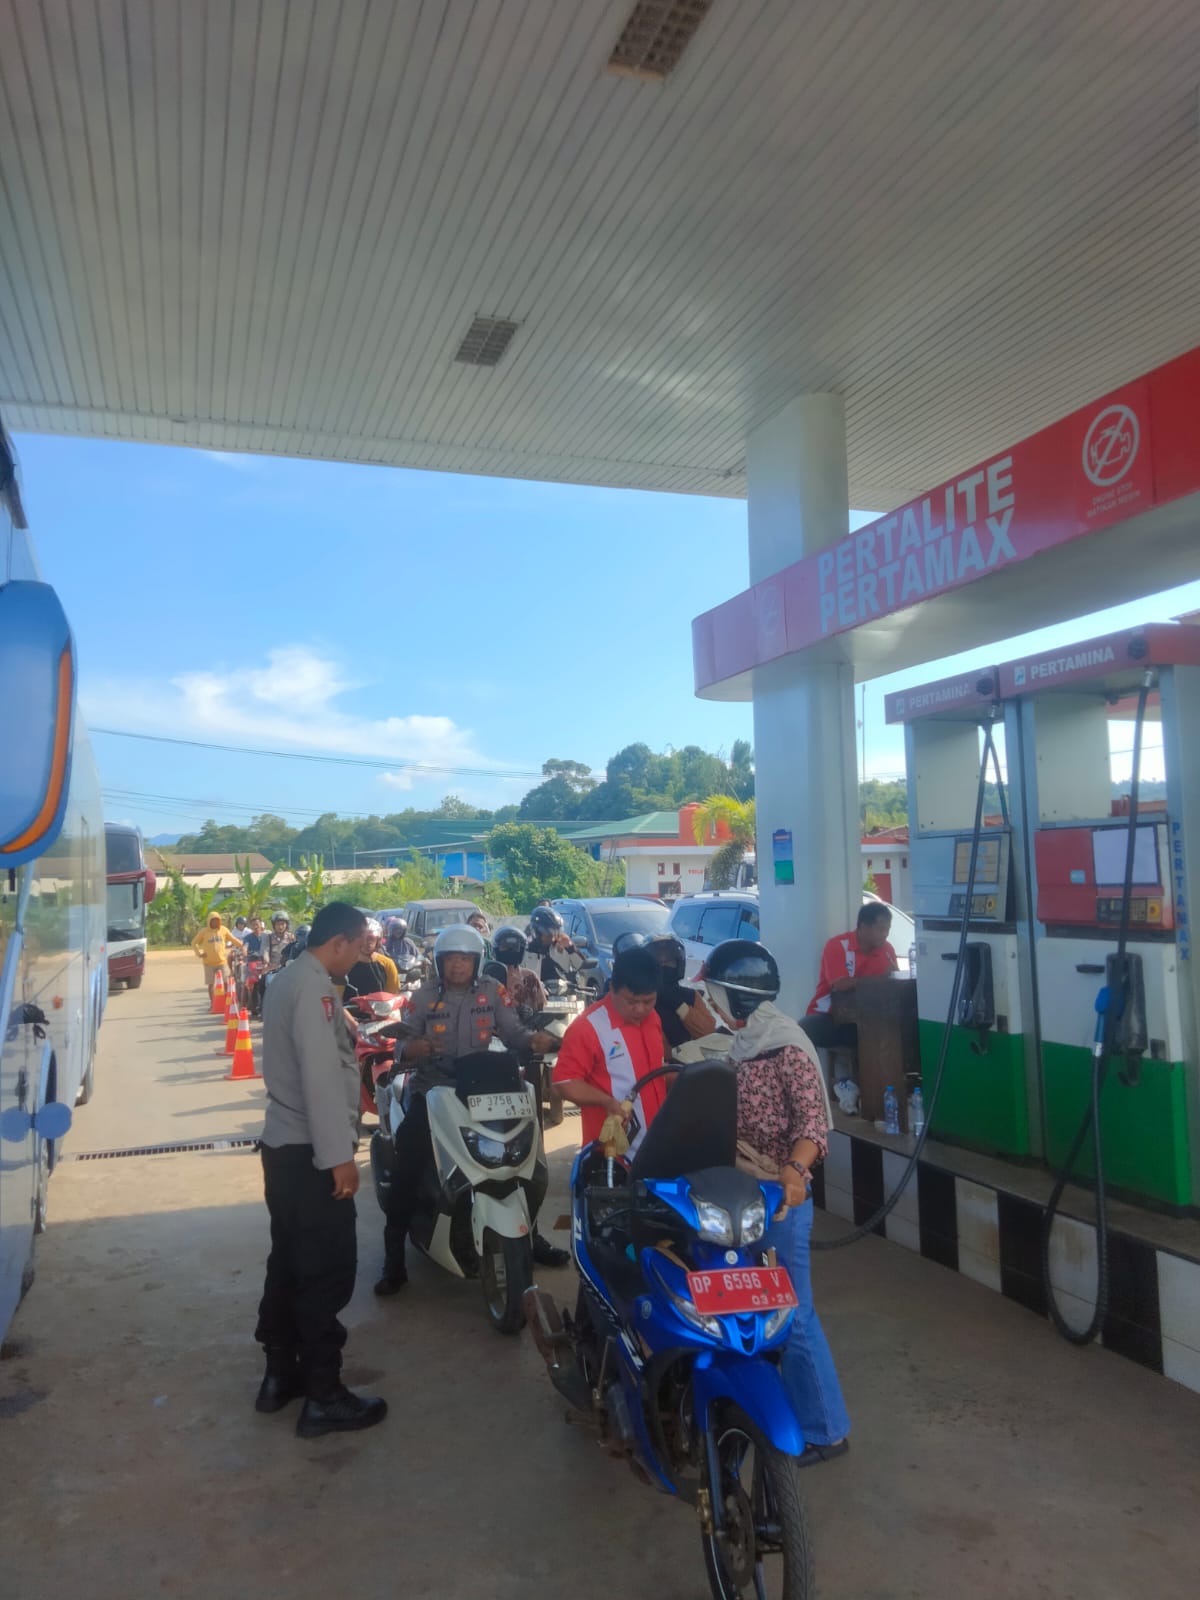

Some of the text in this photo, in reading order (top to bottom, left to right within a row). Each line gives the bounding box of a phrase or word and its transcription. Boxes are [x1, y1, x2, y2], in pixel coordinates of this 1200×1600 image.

[818, 455, 1015, 593] PERTALITE
[820, 507, 1017, 634] PERTAMAX
[1031, 646, 1115, 680] PERTAMINA
[909, 683, 971, 710] PERTAMINA
[1171, 821, 1190, 961] PERTAMAX
[470, 1097, 482, 1108] DP
[691, 1271, 780, 1294] DP 6596 V
